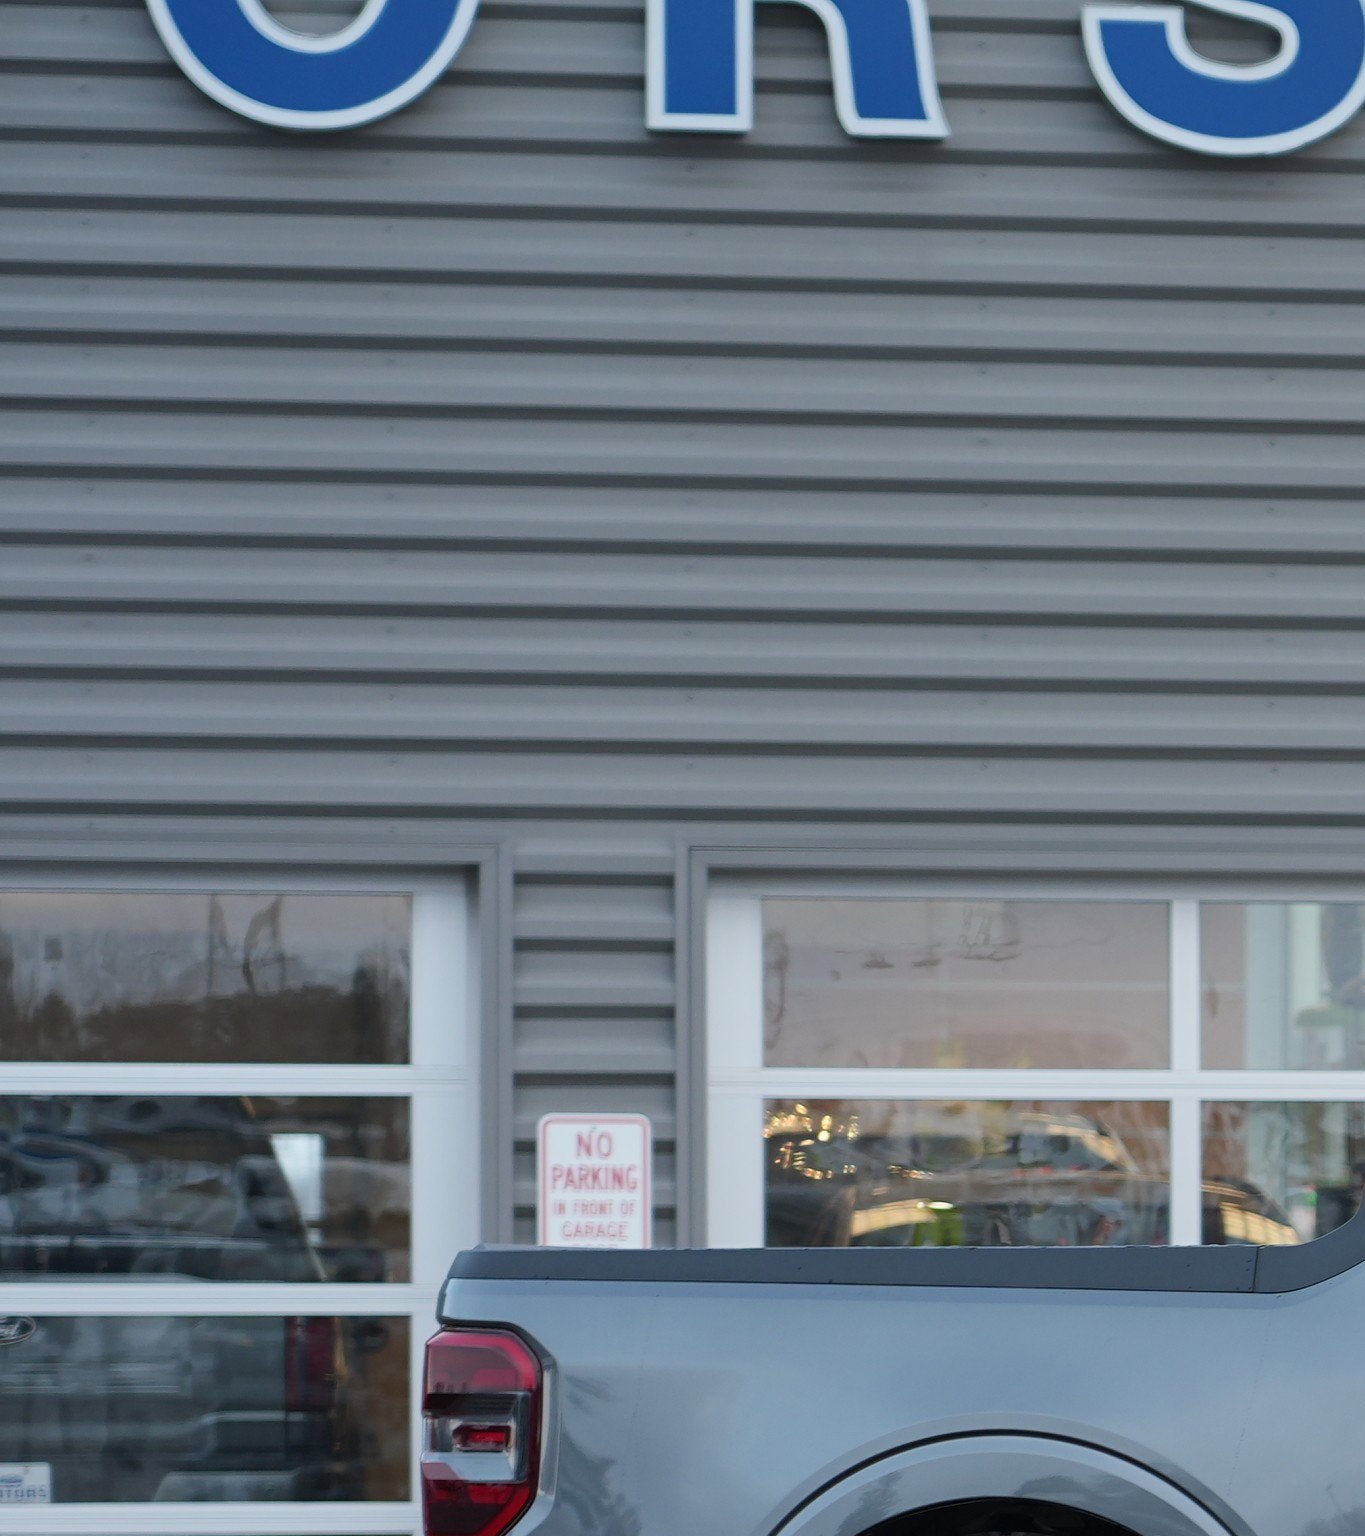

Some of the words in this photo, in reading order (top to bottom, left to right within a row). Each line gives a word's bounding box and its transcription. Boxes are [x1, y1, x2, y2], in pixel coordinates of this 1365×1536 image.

[576, 1132, 613, 1158] NO
[552, 1165, 638, 1191] PARKING
[553, 1200, 566, 1215] IN
[573, 1200, 613, 1215] FRONT
[620, 1200, 636, 1215] OF
[562, 1221, 629, 1239] GARAGE
